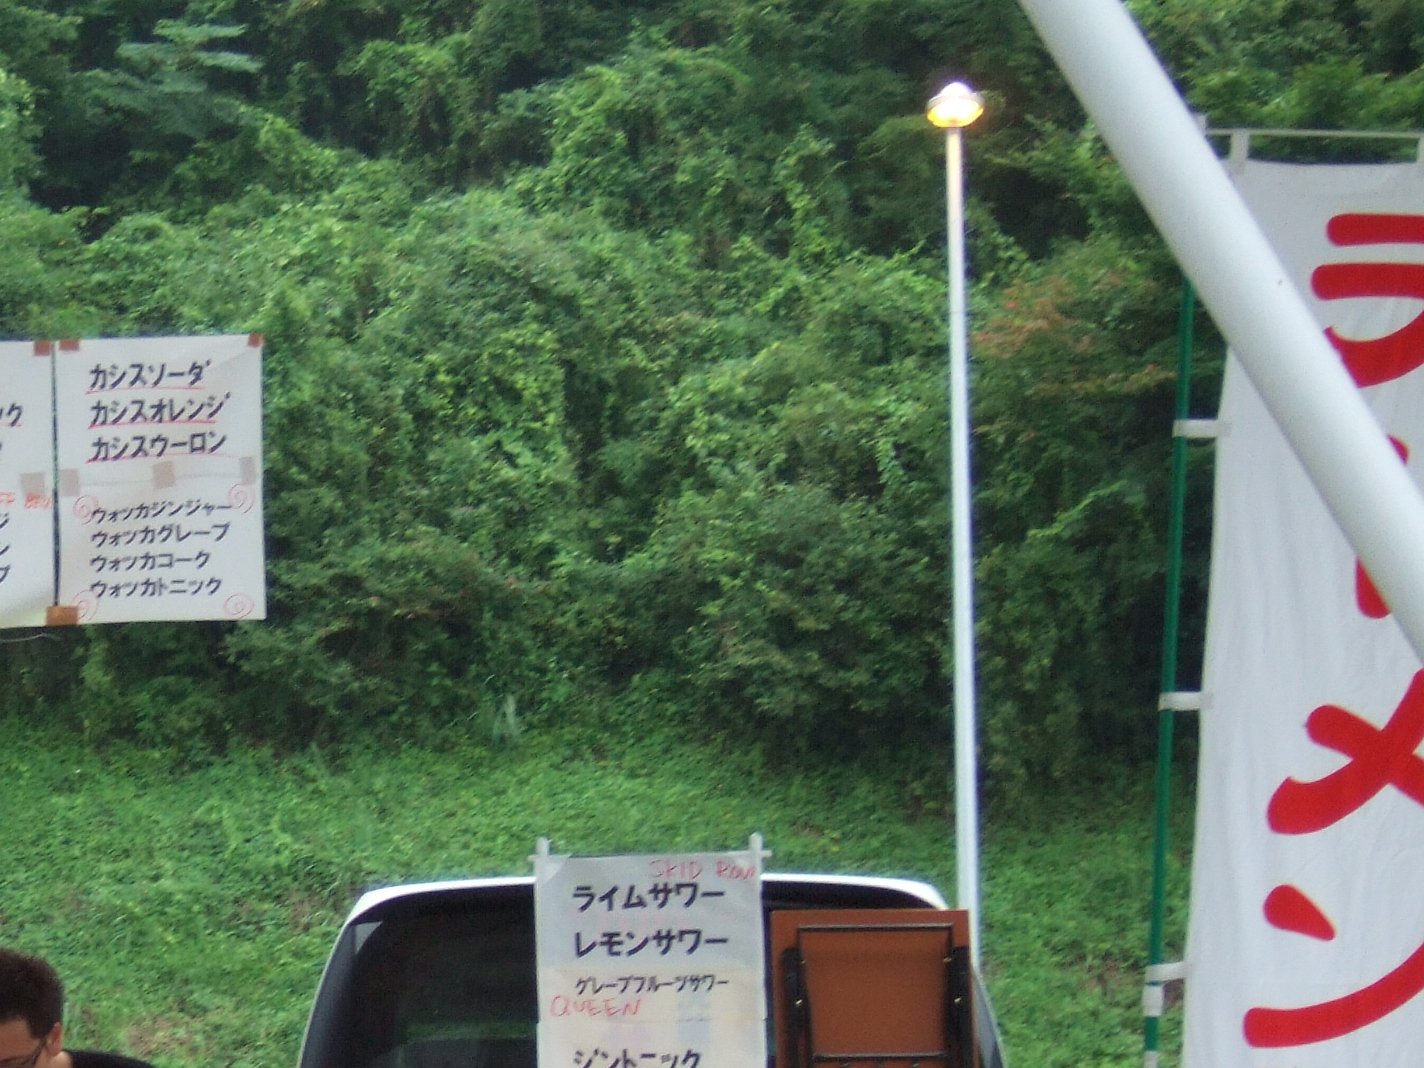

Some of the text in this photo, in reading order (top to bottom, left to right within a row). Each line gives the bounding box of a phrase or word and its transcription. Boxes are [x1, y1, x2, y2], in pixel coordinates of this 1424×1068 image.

[89, 358, 211, 390] カシスソーダ
[89, 392, 232, 428] カシスオレンジ
[89, 431, 228, 462] カシスウーロン
[88, 500, 234, 525] ウォッカジンジャー
[89, 521, 231, 544] ウォッカグレープ
[89, 550, 212, 573] ウォッカコーク
[88, 577, 223, 598] ウォッカトニック
[572, 882, 725, 912] ライムサワー
[574, 929, 728, 959] レモンサワー
